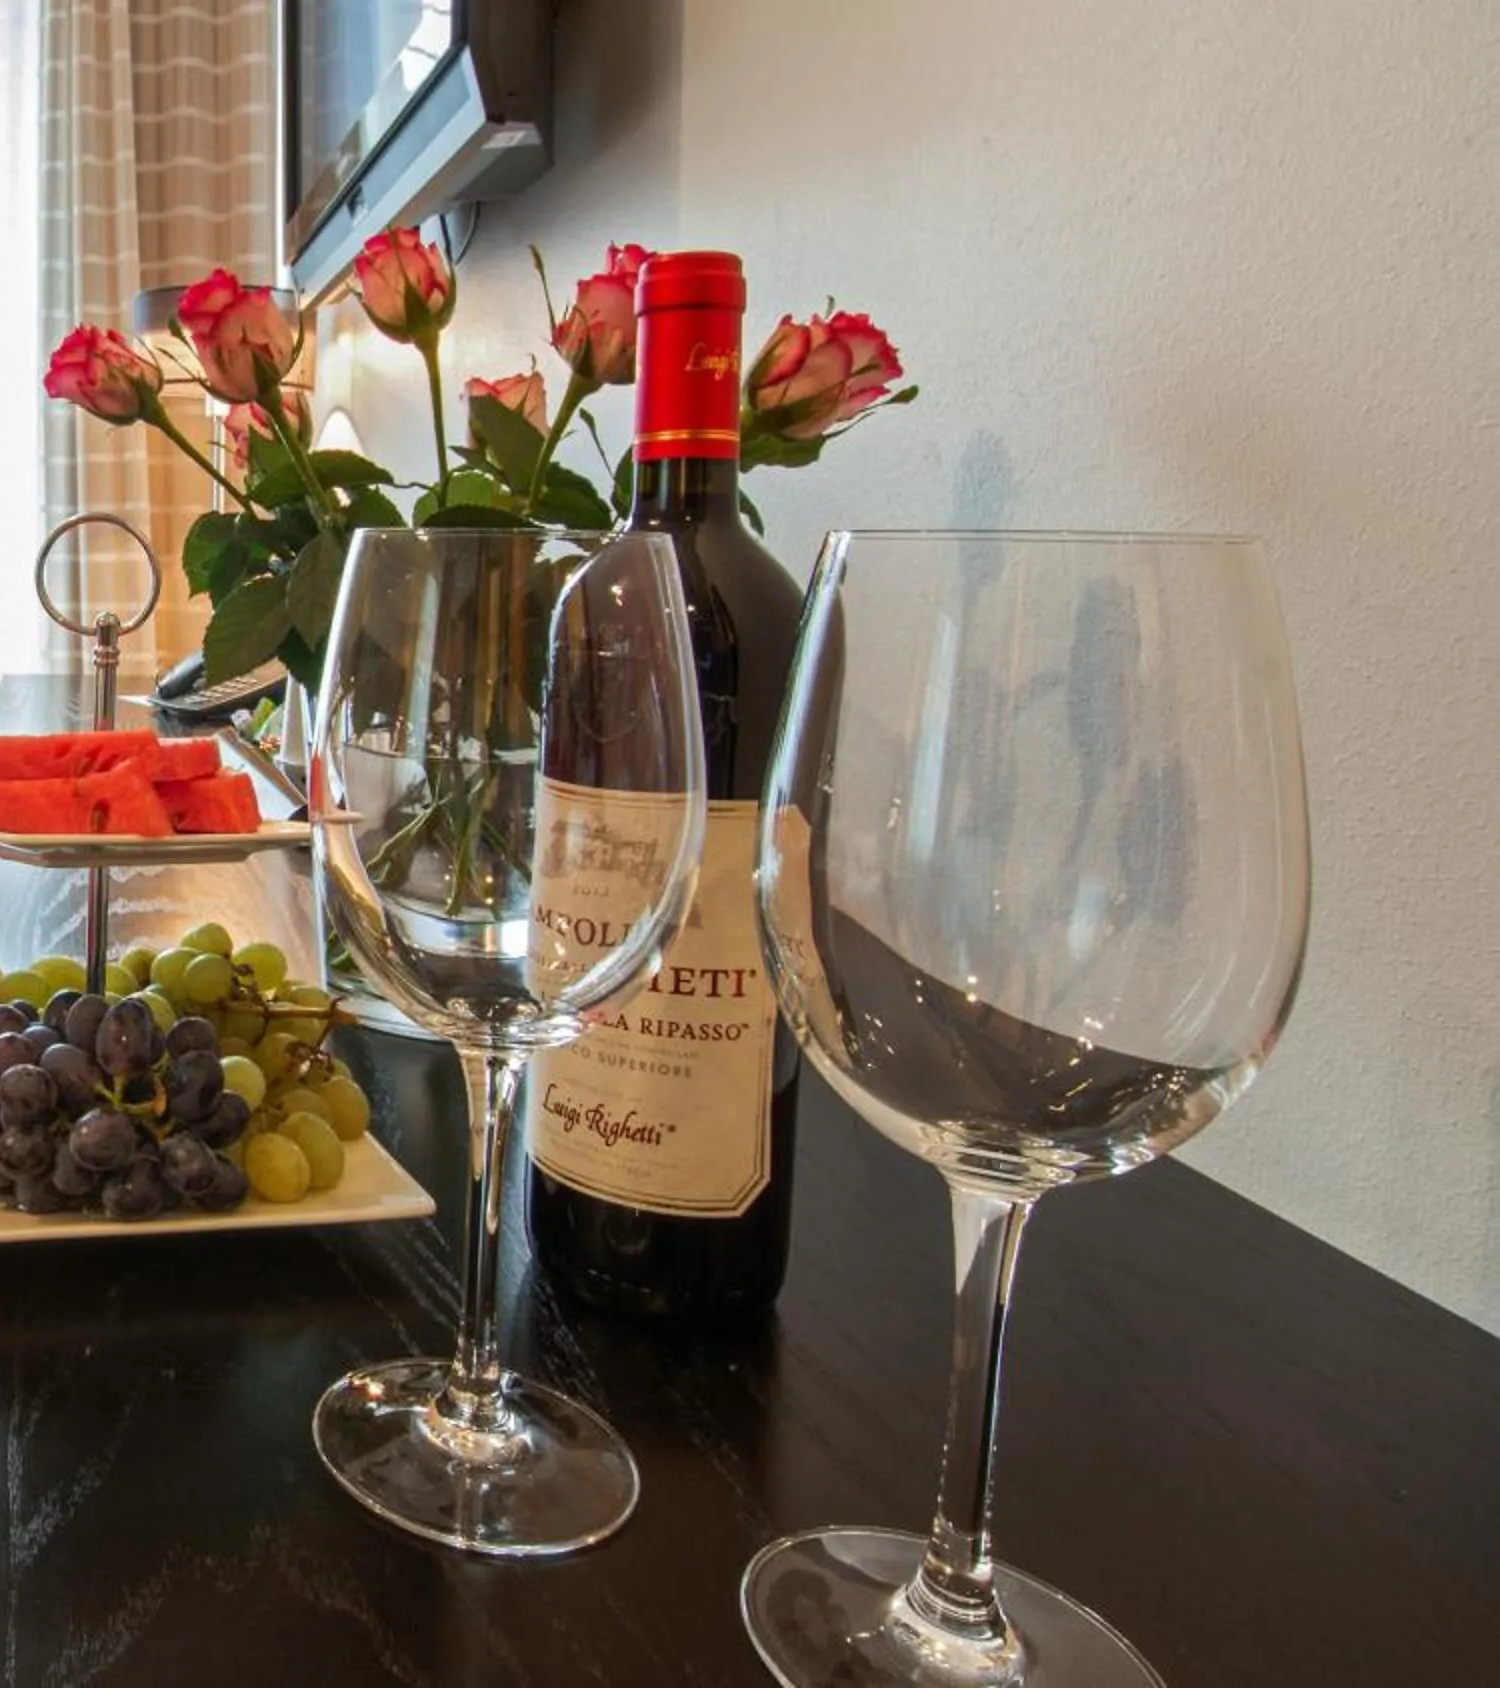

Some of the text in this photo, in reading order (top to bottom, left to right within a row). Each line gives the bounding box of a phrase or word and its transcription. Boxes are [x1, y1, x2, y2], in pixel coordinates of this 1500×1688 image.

[640, 1017, 742, 1042] RIPASSO
[597, 1050, 692, 1079] SUPERIORE
[543, 1083, 583, 1133] Luigi
[585, 1103, 663, 1147] Righetti
